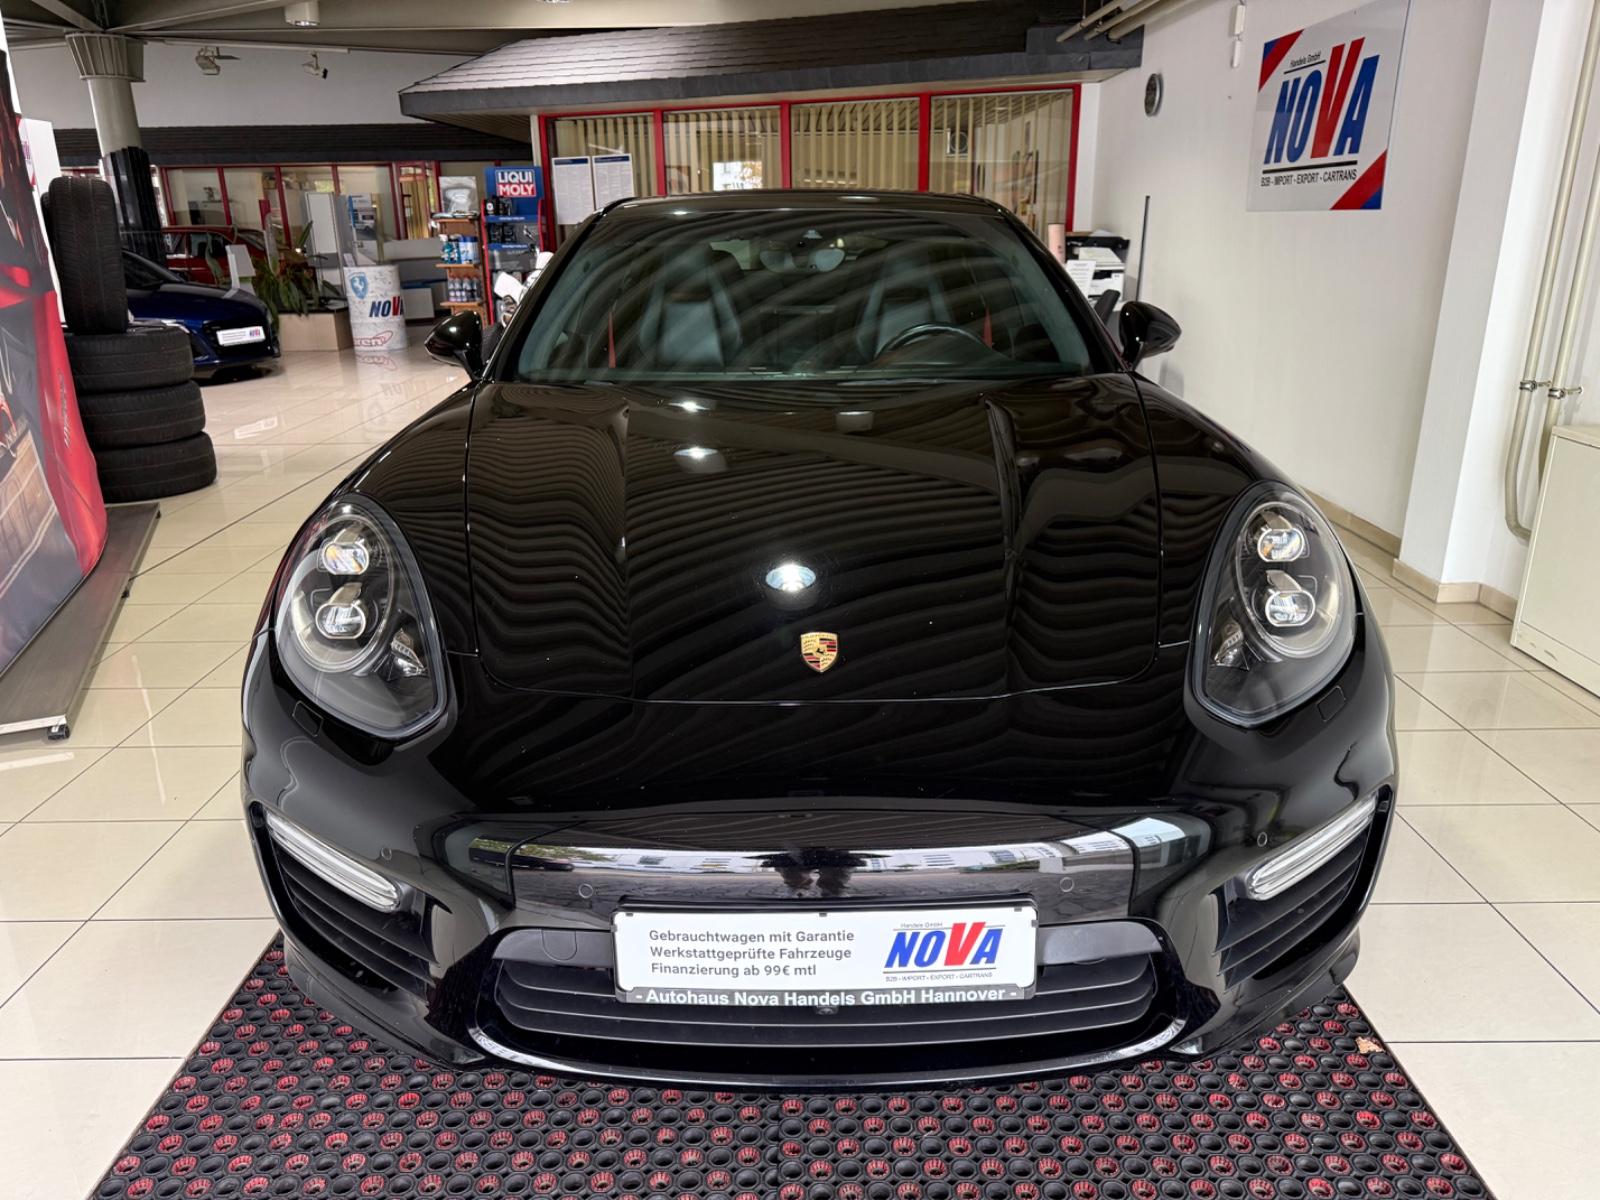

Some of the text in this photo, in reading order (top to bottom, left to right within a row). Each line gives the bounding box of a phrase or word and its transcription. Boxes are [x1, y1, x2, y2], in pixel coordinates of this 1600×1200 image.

[1263, 37, 1380, 165] NOVA
[498, 171, 533, 183] LIQUI
[1274, 174, 1293, 186] IMPORT
[1296, 172, 1319, 184] EXPORT
[1322, 169, 1358, 183] CARTRANS
[499, 184, 534, 196] MOLY
[649, 930, 854, 945] Gebrauchtwagen mit Garantie
[884, 921, 1003, 968] NOVA
[650, 946, 851, 962] Werkstattgeprüfte Fahrzeuge
[651, 963, 816, 979] Finanzierung ab 99€ mtl
[645, 989, 729, 1005] Autohaus
[734, 991, 779, 1006] Nova
[783, 991, 855, 1006] Handels
[860, 989, 915, 1006] GmbH
[921, 988, 1006, 1004] Hannover
